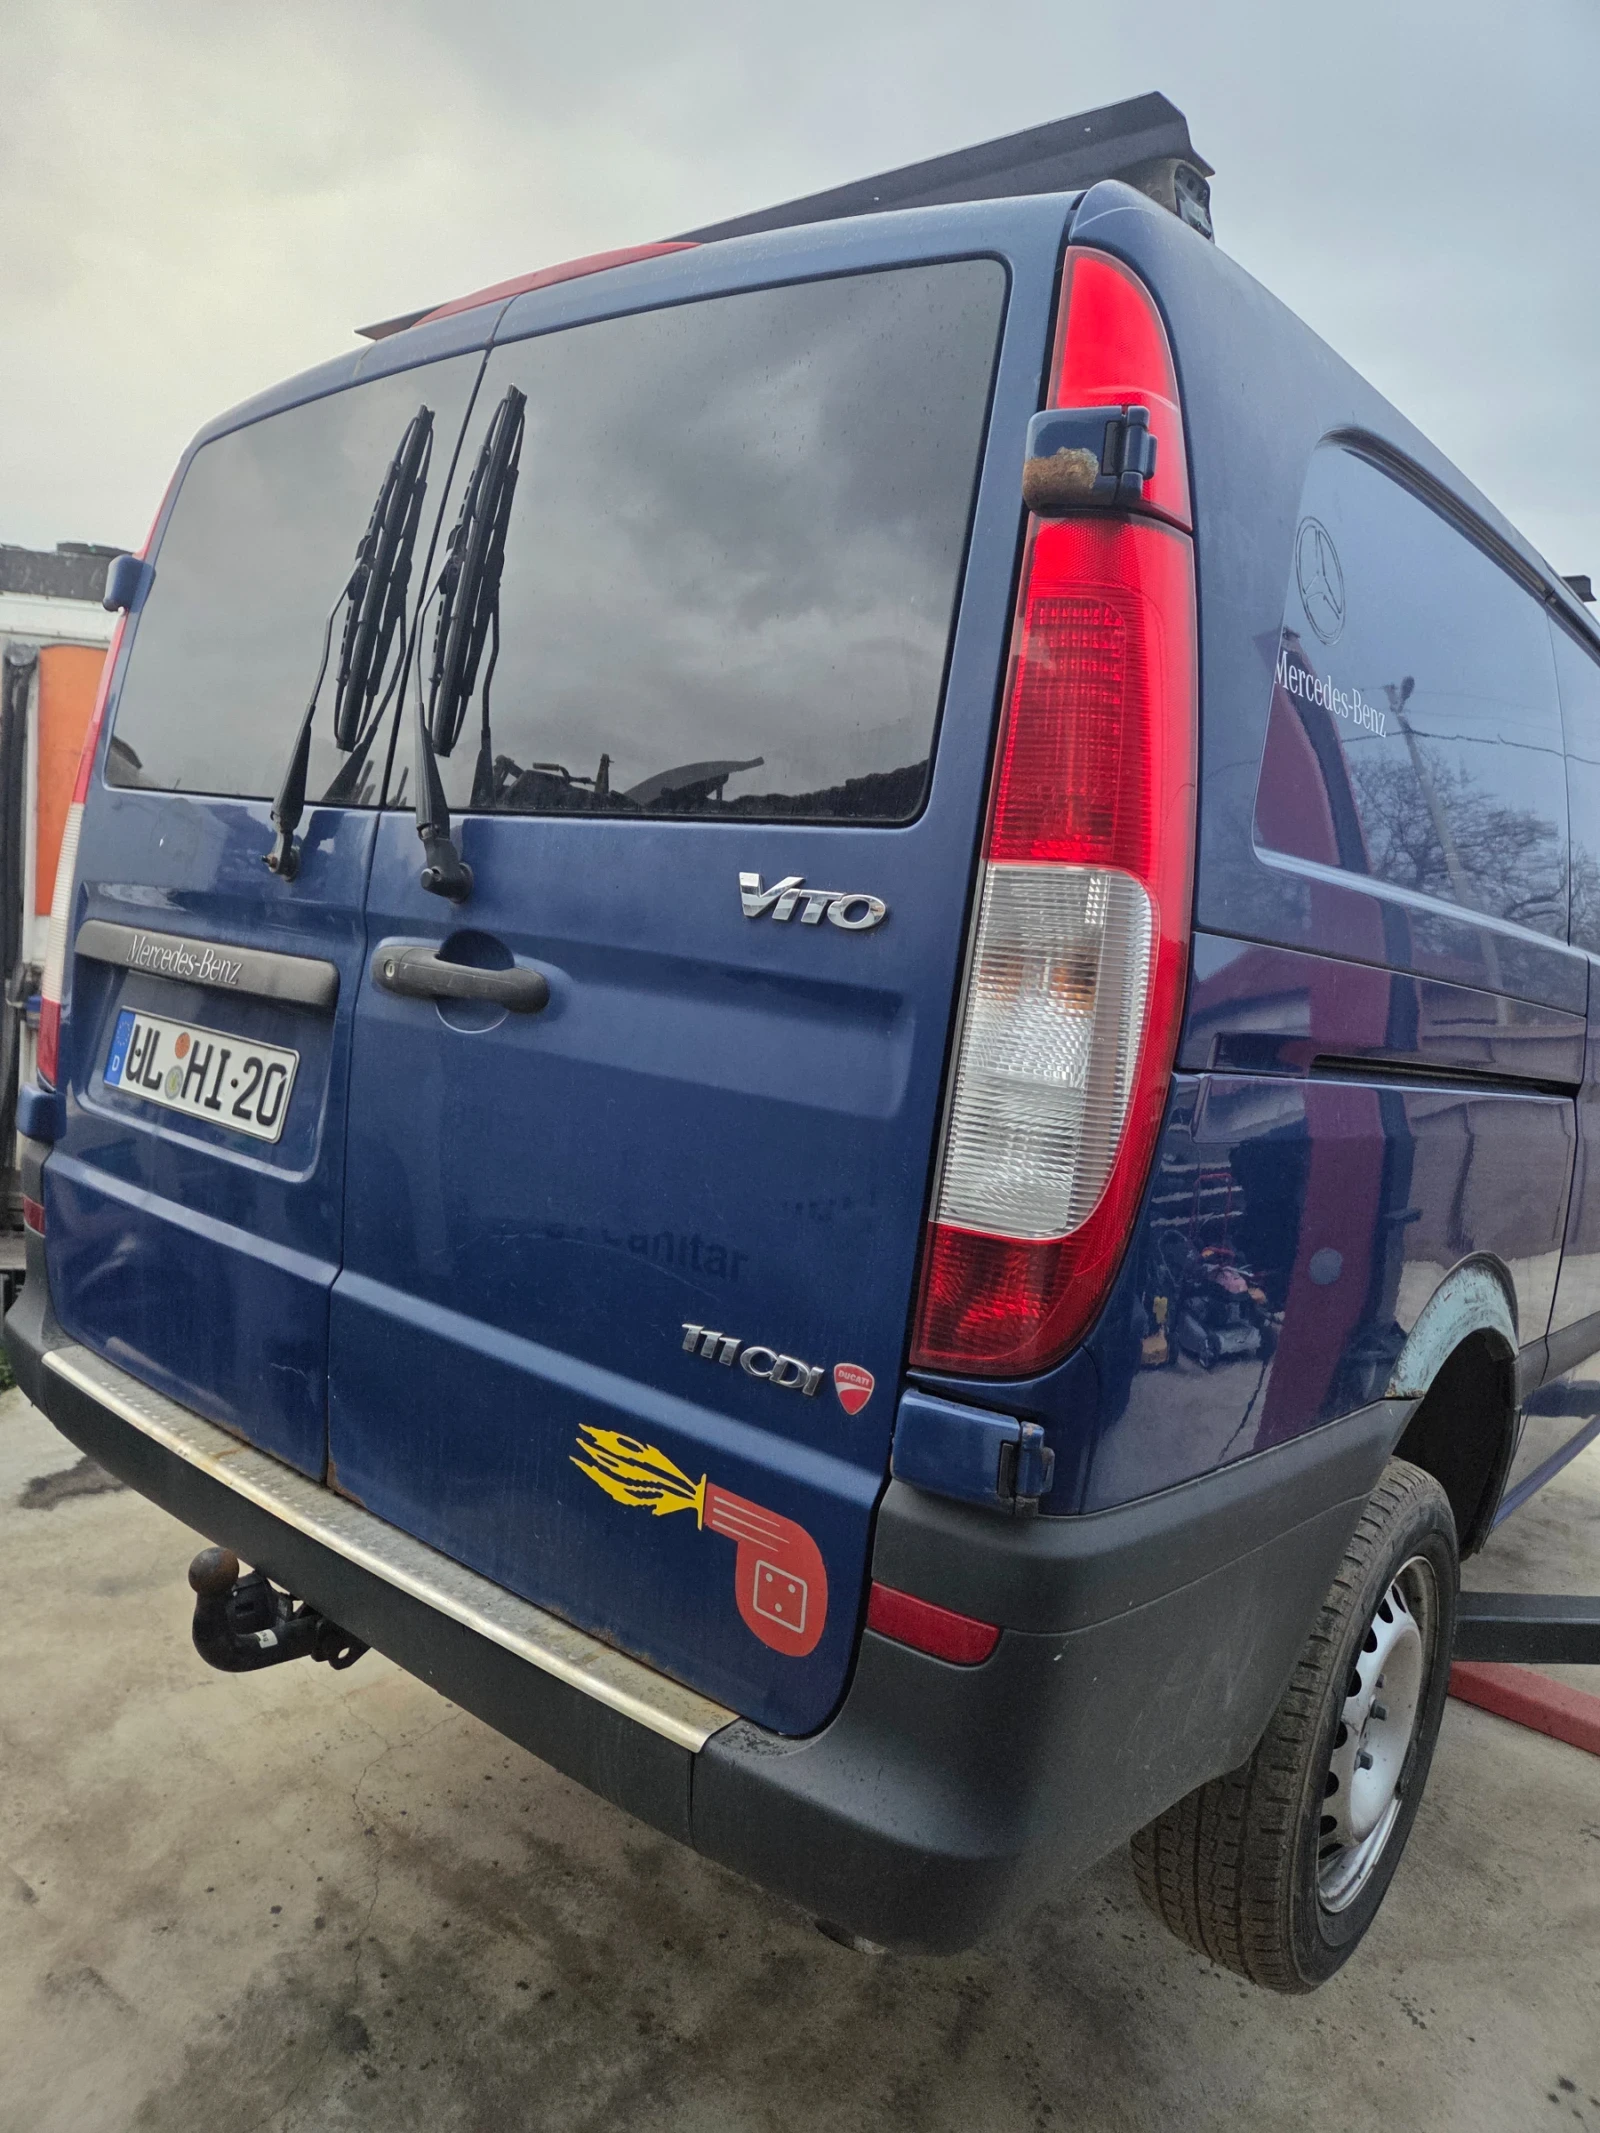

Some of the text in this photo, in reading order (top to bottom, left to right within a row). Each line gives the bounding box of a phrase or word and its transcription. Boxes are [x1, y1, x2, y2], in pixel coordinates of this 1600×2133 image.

[1274, 649, 1387, 738] Mercedes-Benz
[126, 933, 243, 985] Mercedes-Benz
[111, 1055, 120, 1072] D
[740, 1346, 825, 1396] CDI
[838, 1369, 870, 1386] DUCATI
